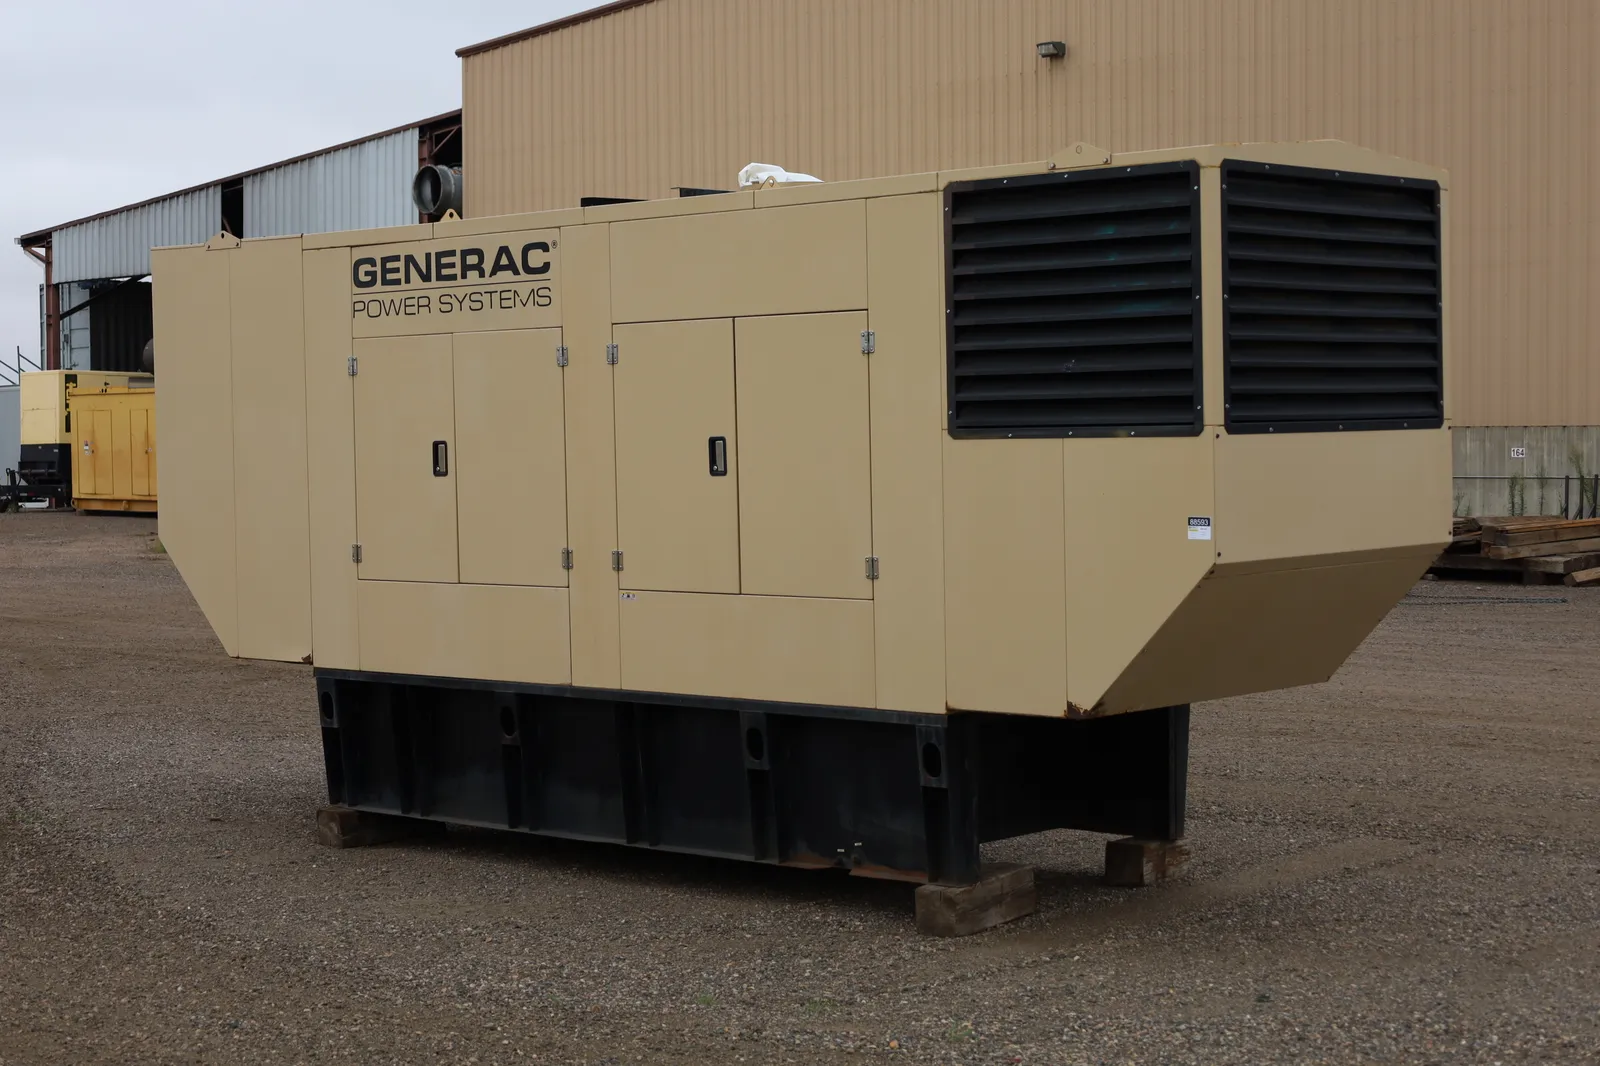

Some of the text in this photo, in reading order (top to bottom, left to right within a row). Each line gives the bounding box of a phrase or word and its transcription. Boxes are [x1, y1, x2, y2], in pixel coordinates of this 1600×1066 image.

[353, 287, 551, 318] POWER SYSTEMS
[1512, 448, 1525, 457] 164
[1189, 518, 1209, 526] 88593
